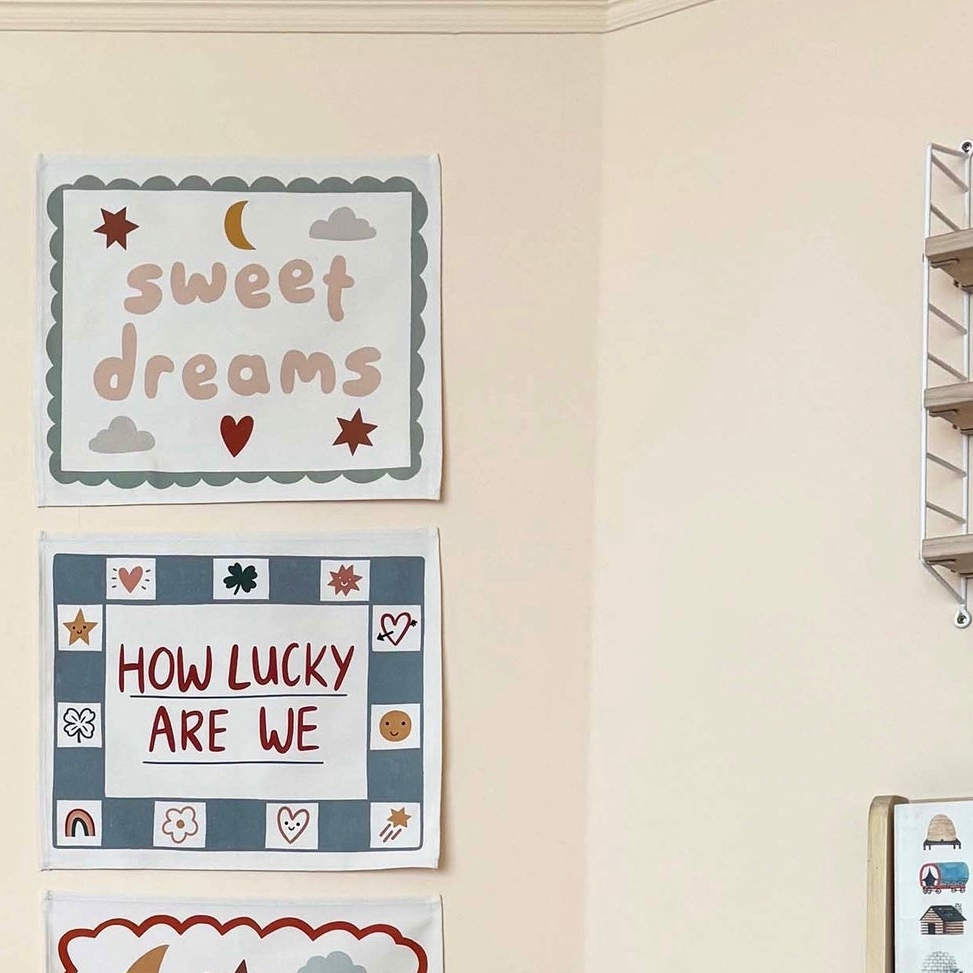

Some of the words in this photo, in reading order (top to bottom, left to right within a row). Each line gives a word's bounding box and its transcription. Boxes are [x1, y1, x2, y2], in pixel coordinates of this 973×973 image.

[124, 255, 355, 322] sweet
[93, 320, 381, 401] dreams
[119, 644, 212, 693] HOW
[228, 642, 354, 691] LUCKY
[149, 706, 228, 753] ARE
[259, 706, 319, 754] WE
